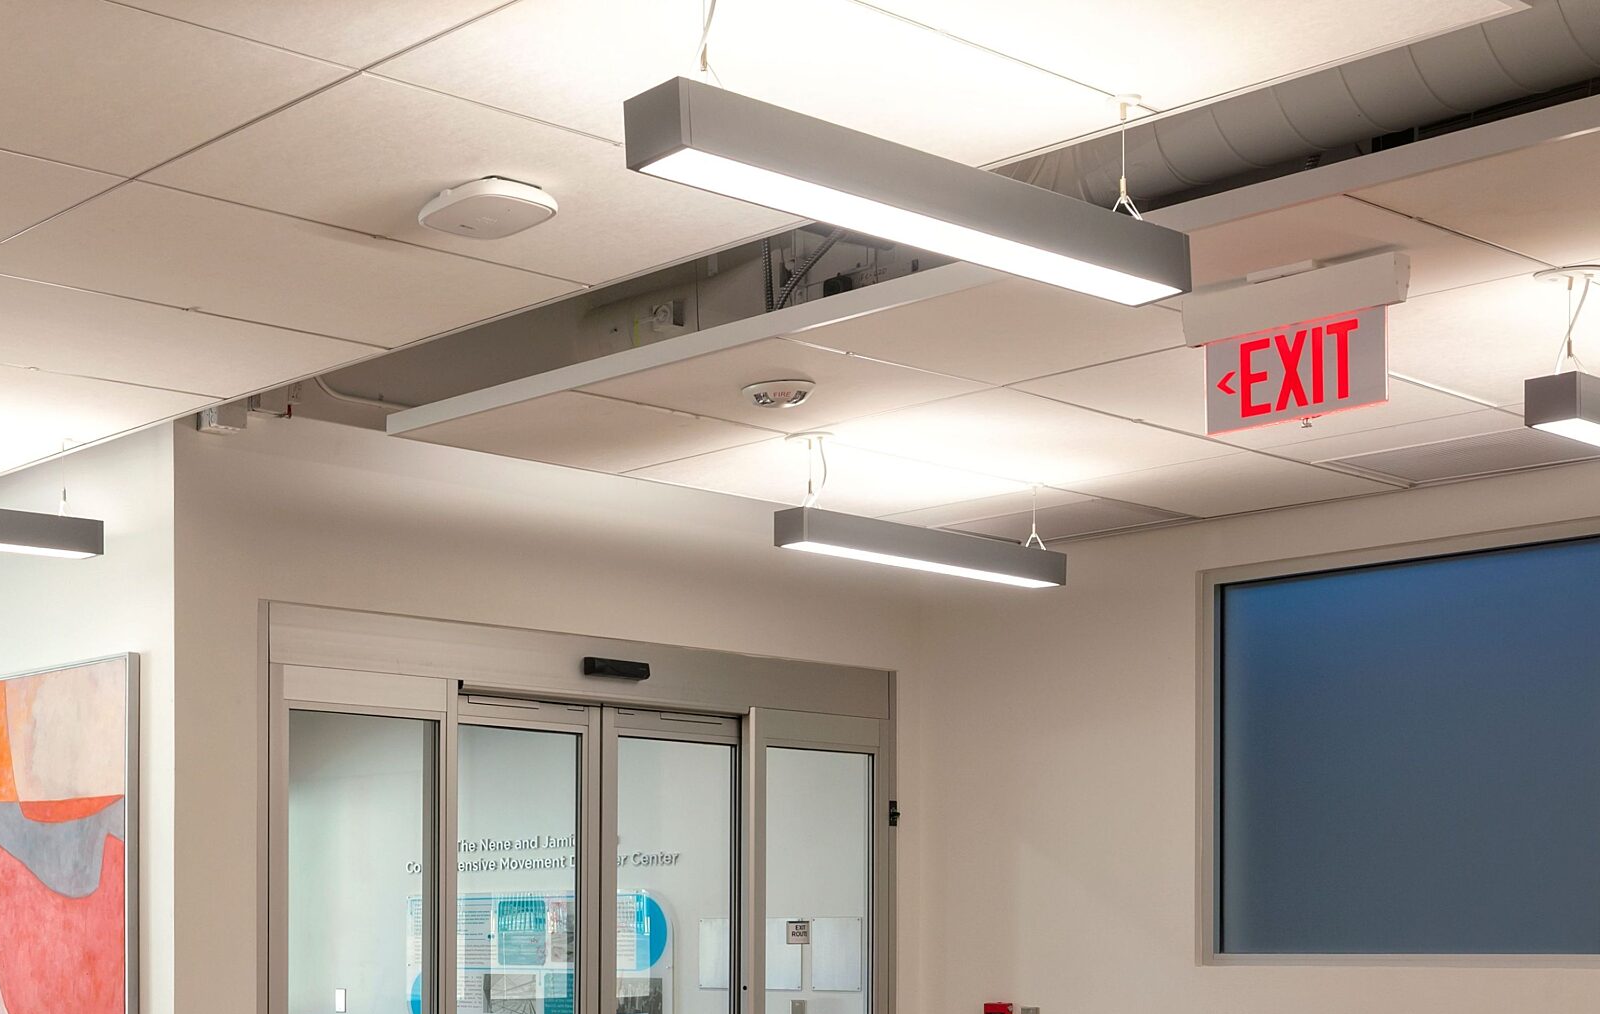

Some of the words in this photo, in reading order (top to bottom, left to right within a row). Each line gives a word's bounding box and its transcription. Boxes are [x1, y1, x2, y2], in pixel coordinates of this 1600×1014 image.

[1239, 318, 1359, 418] EXIT
[481, 838, 512, 852] Nene
[515, 836, 540, 850] and
[405, 858, 497, 873] Coensive
[499, 856, 567, 871] Movement
[632, 850, 680, 867] Center
